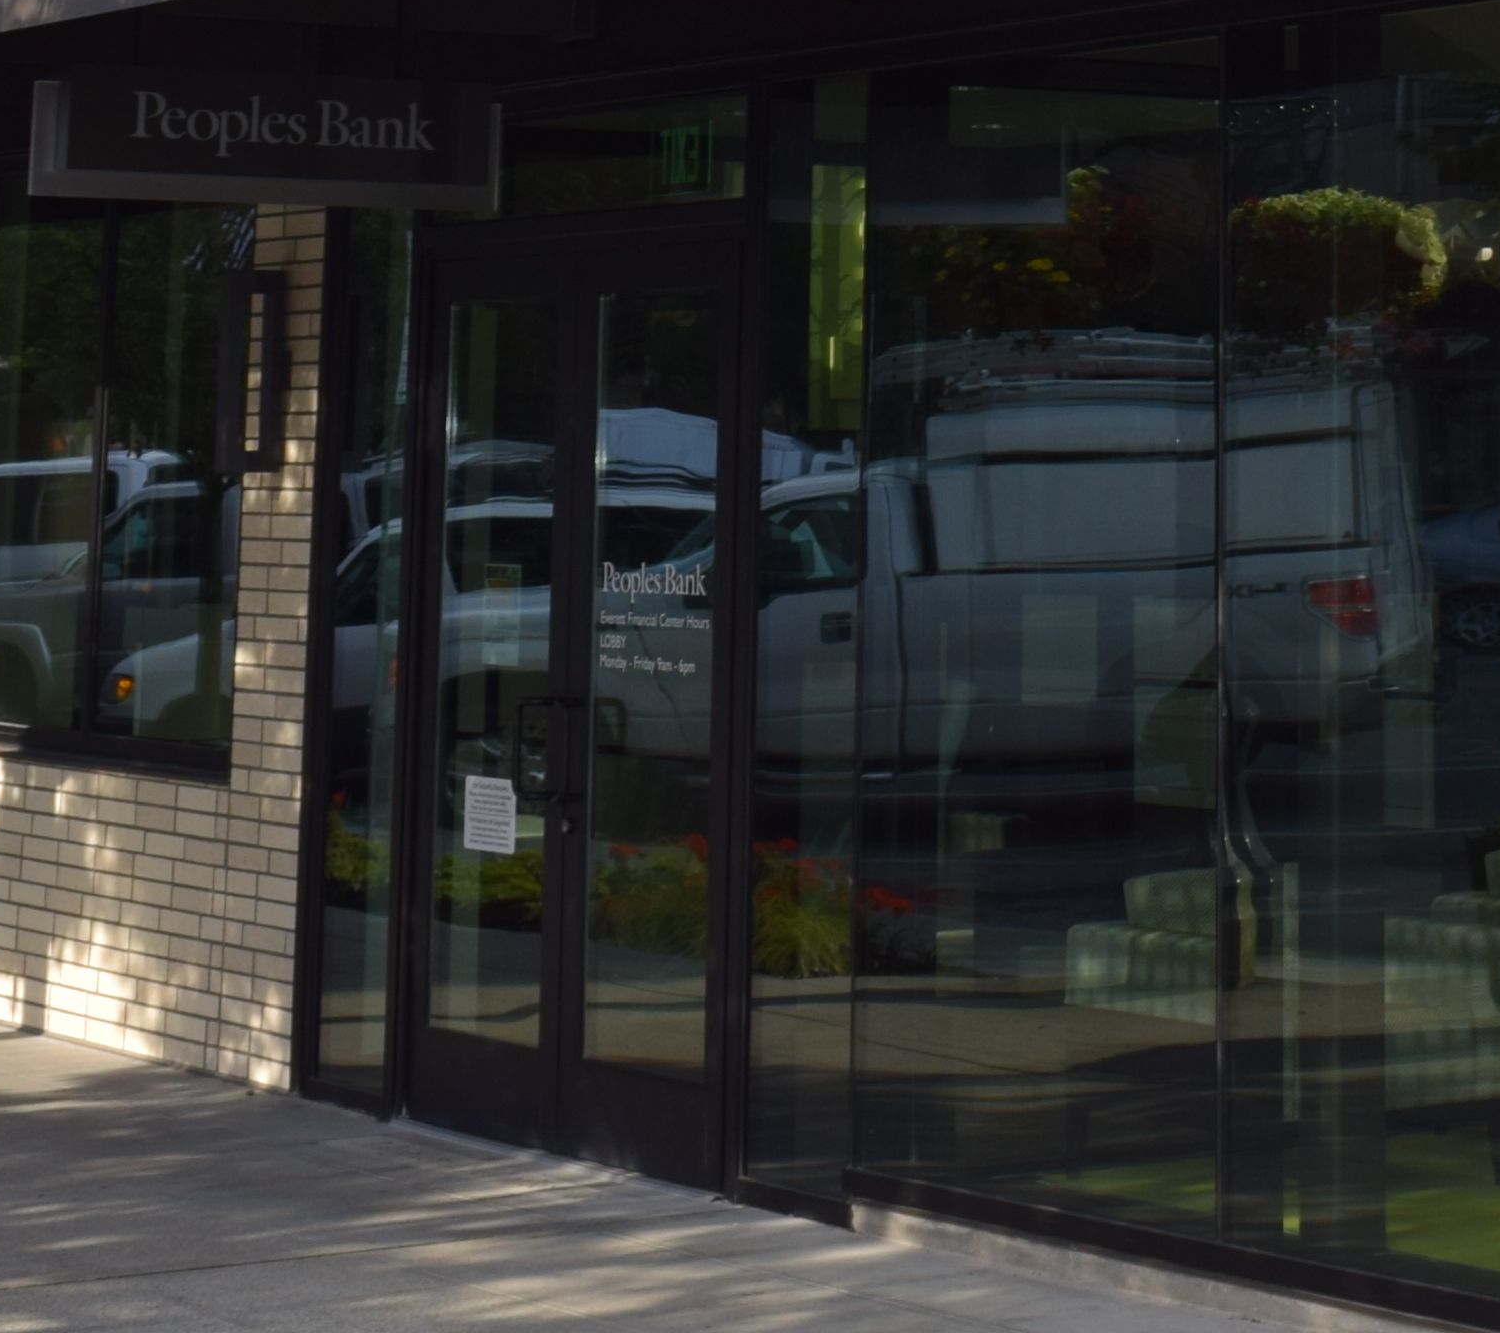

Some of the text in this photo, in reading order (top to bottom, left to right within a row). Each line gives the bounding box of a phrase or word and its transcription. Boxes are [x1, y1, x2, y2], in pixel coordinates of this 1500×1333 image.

[130, 89, 435, 158] Peoples Bank
[601, 561, 707, 603] Peoples Bank
[599, 634, 627, 649] LOBBY
[599, 654, 627, 673] Monday
[633, 655, 656, 675] Friday
